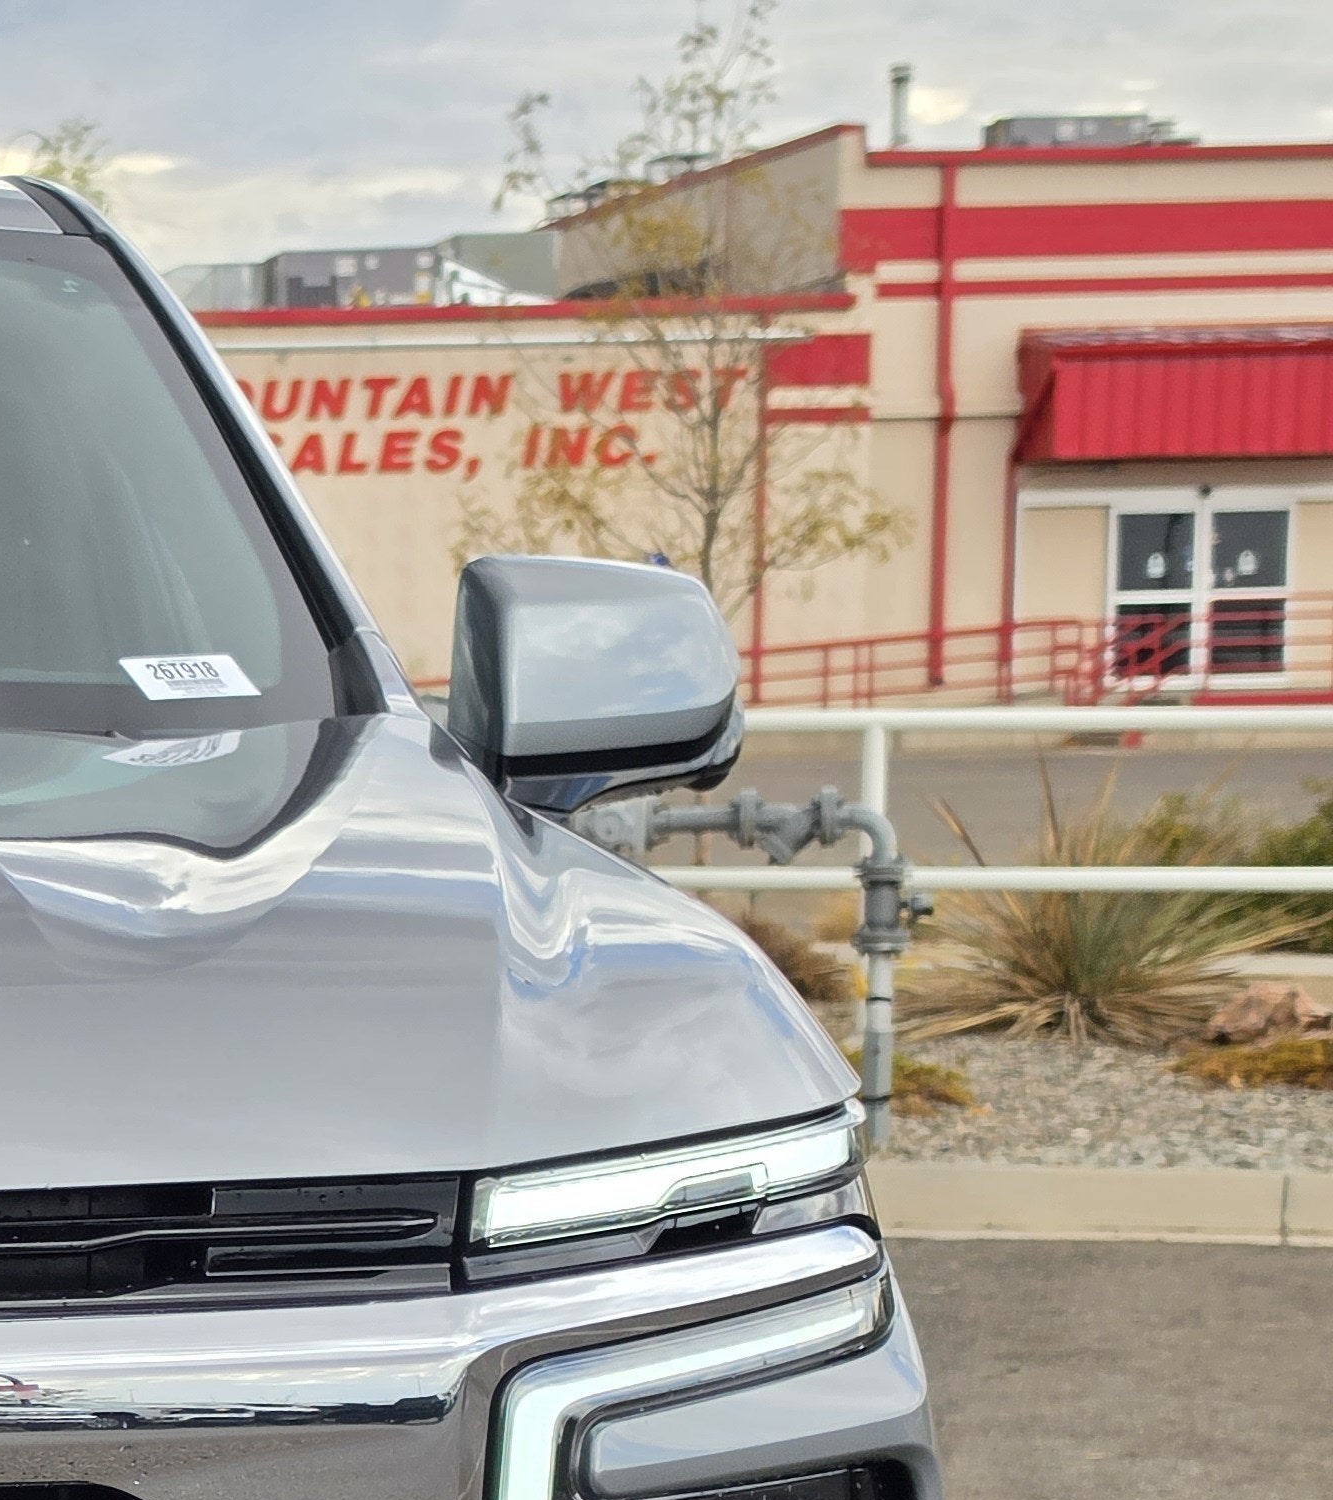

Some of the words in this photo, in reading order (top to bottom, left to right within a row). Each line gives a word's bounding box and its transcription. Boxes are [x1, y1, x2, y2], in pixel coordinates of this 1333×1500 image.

[557, 368, 748, 413] WEST
[271, 428, 480, 482] ALES,
[522, 424, 656, 470] INC.
[145, 661, 220, 680] 26T918
